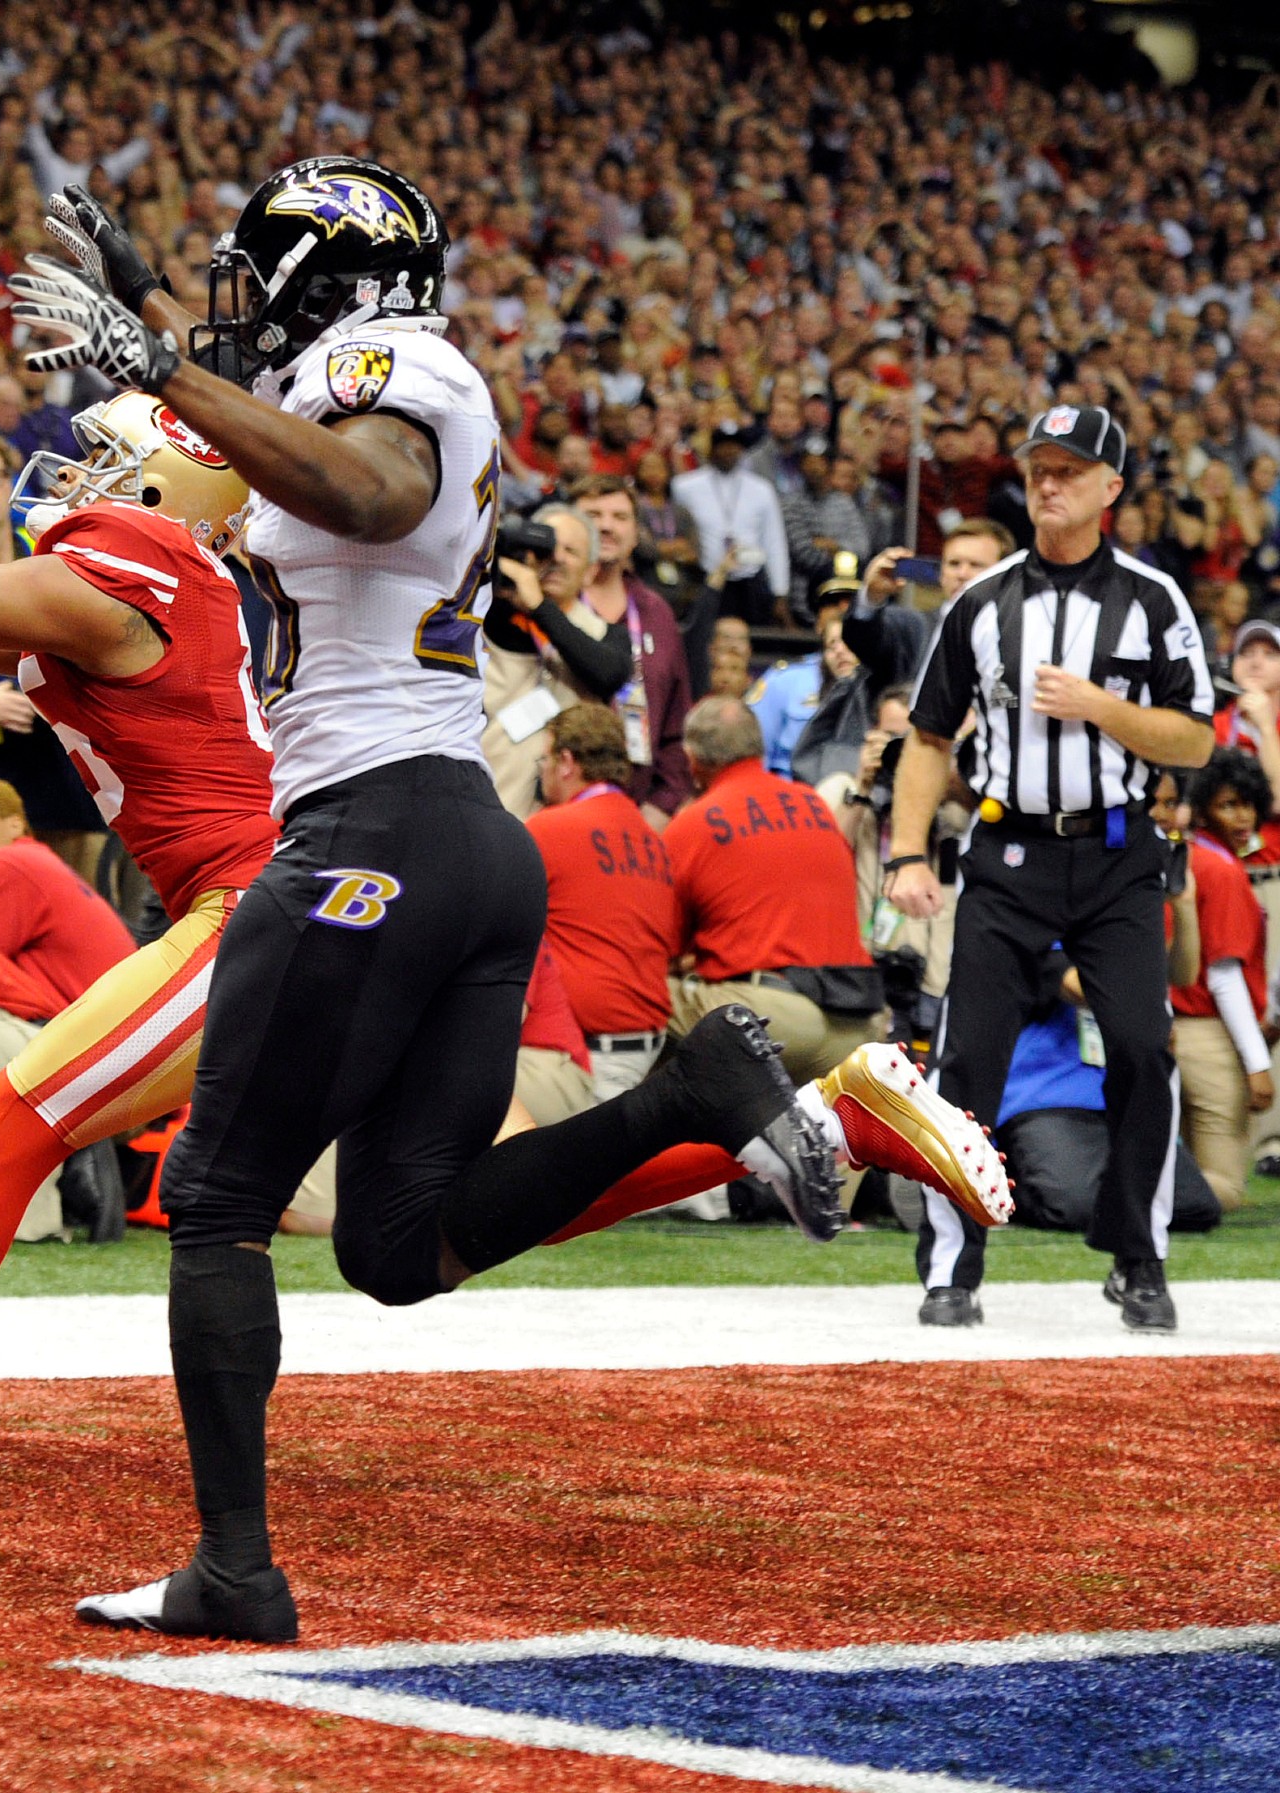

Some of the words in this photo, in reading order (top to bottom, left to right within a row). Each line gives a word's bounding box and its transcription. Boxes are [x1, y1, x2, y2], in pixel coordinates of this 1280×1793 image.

[360, 289, 378, 301] NFL
[420, 276, 434, 307] 2
[330, 343, 391, 357] RAVENS
[1178, 626, 1198, 649] 2
[307, 866, 405, 930] B
